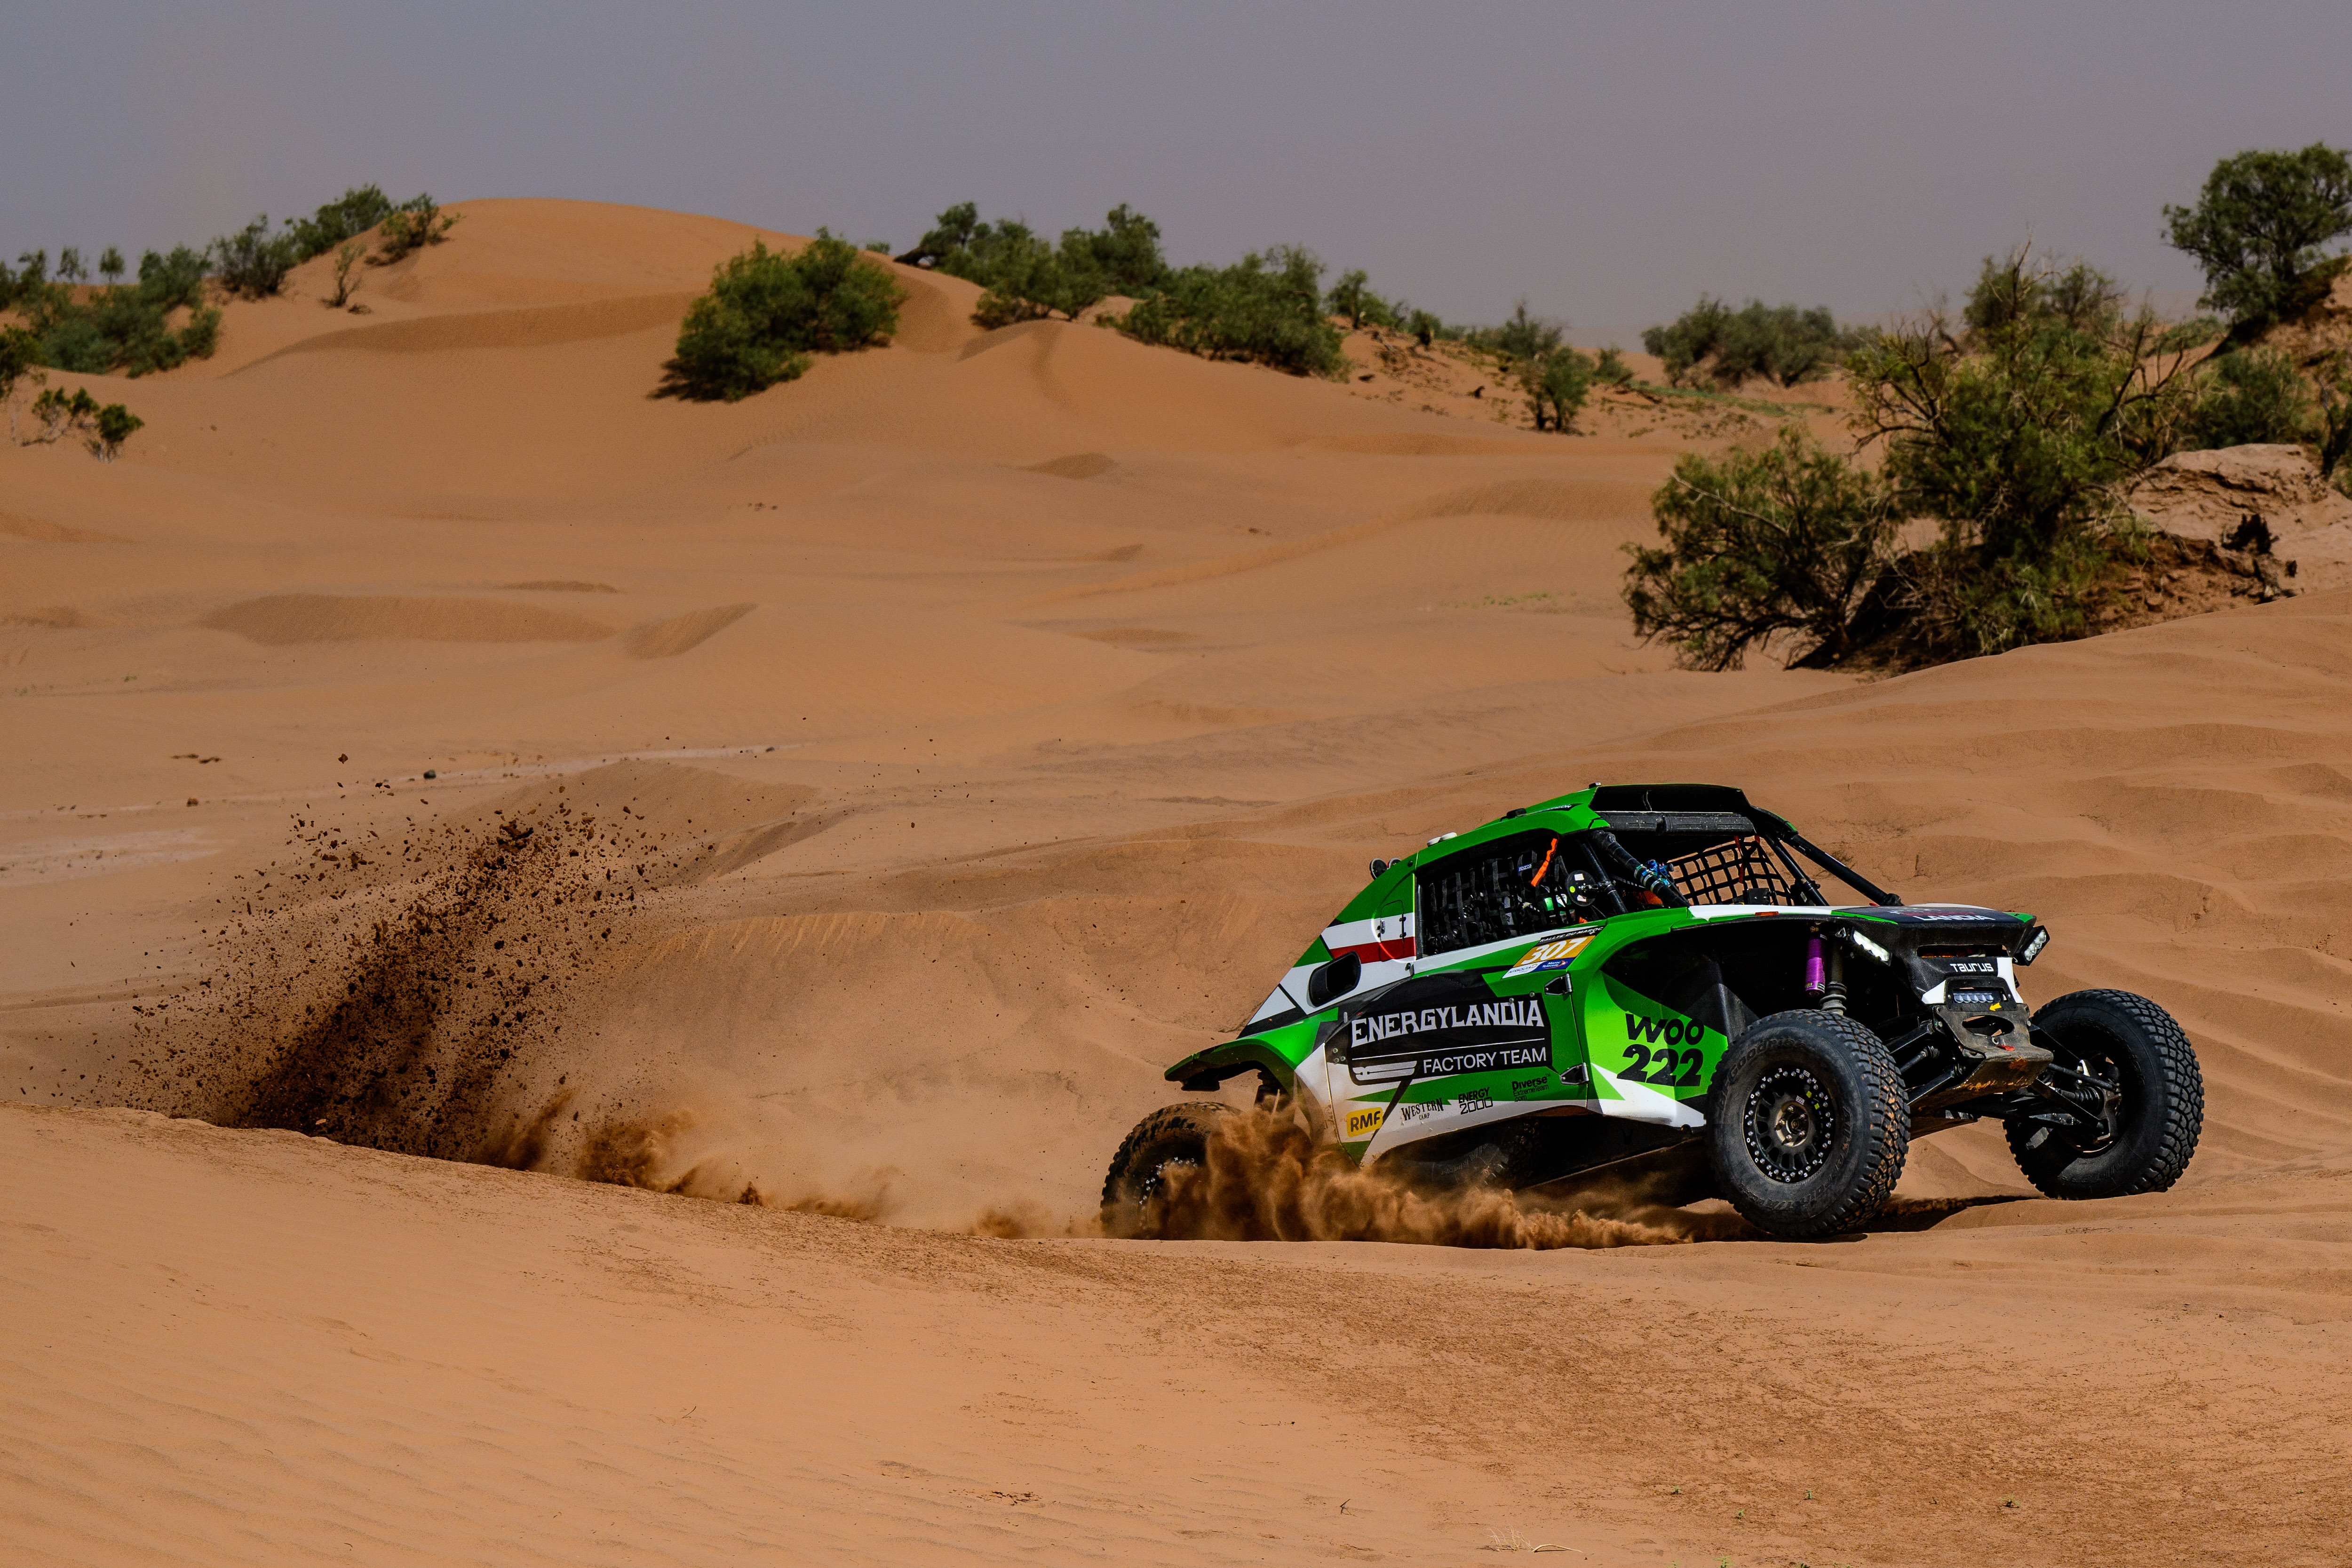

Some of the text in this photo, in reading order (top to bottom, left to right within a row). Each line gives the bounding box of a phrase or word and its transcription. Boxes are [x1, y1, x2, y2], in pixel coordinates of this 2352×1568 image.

[1521, 937, 1588, 964] 307
[1351, 1000, 1544, 1048] ENERGYLANDIA
[1423, 1047, 1547, 1074] FACTORY TEAM
[1616, 1043, 1704, 1087] 222
[1511, 1075, 1548, 1090] Diverse
[1513, 1083, 1549, 1097] ExtremeTeam
[1458, 1087, 1490, 1104] ENERGY
[1460, 1097, 1493, 1115] 2000
[1401, 1098, 1444, 1121] WESTERN
[1351, 1111, 1381, 1132] RMF
